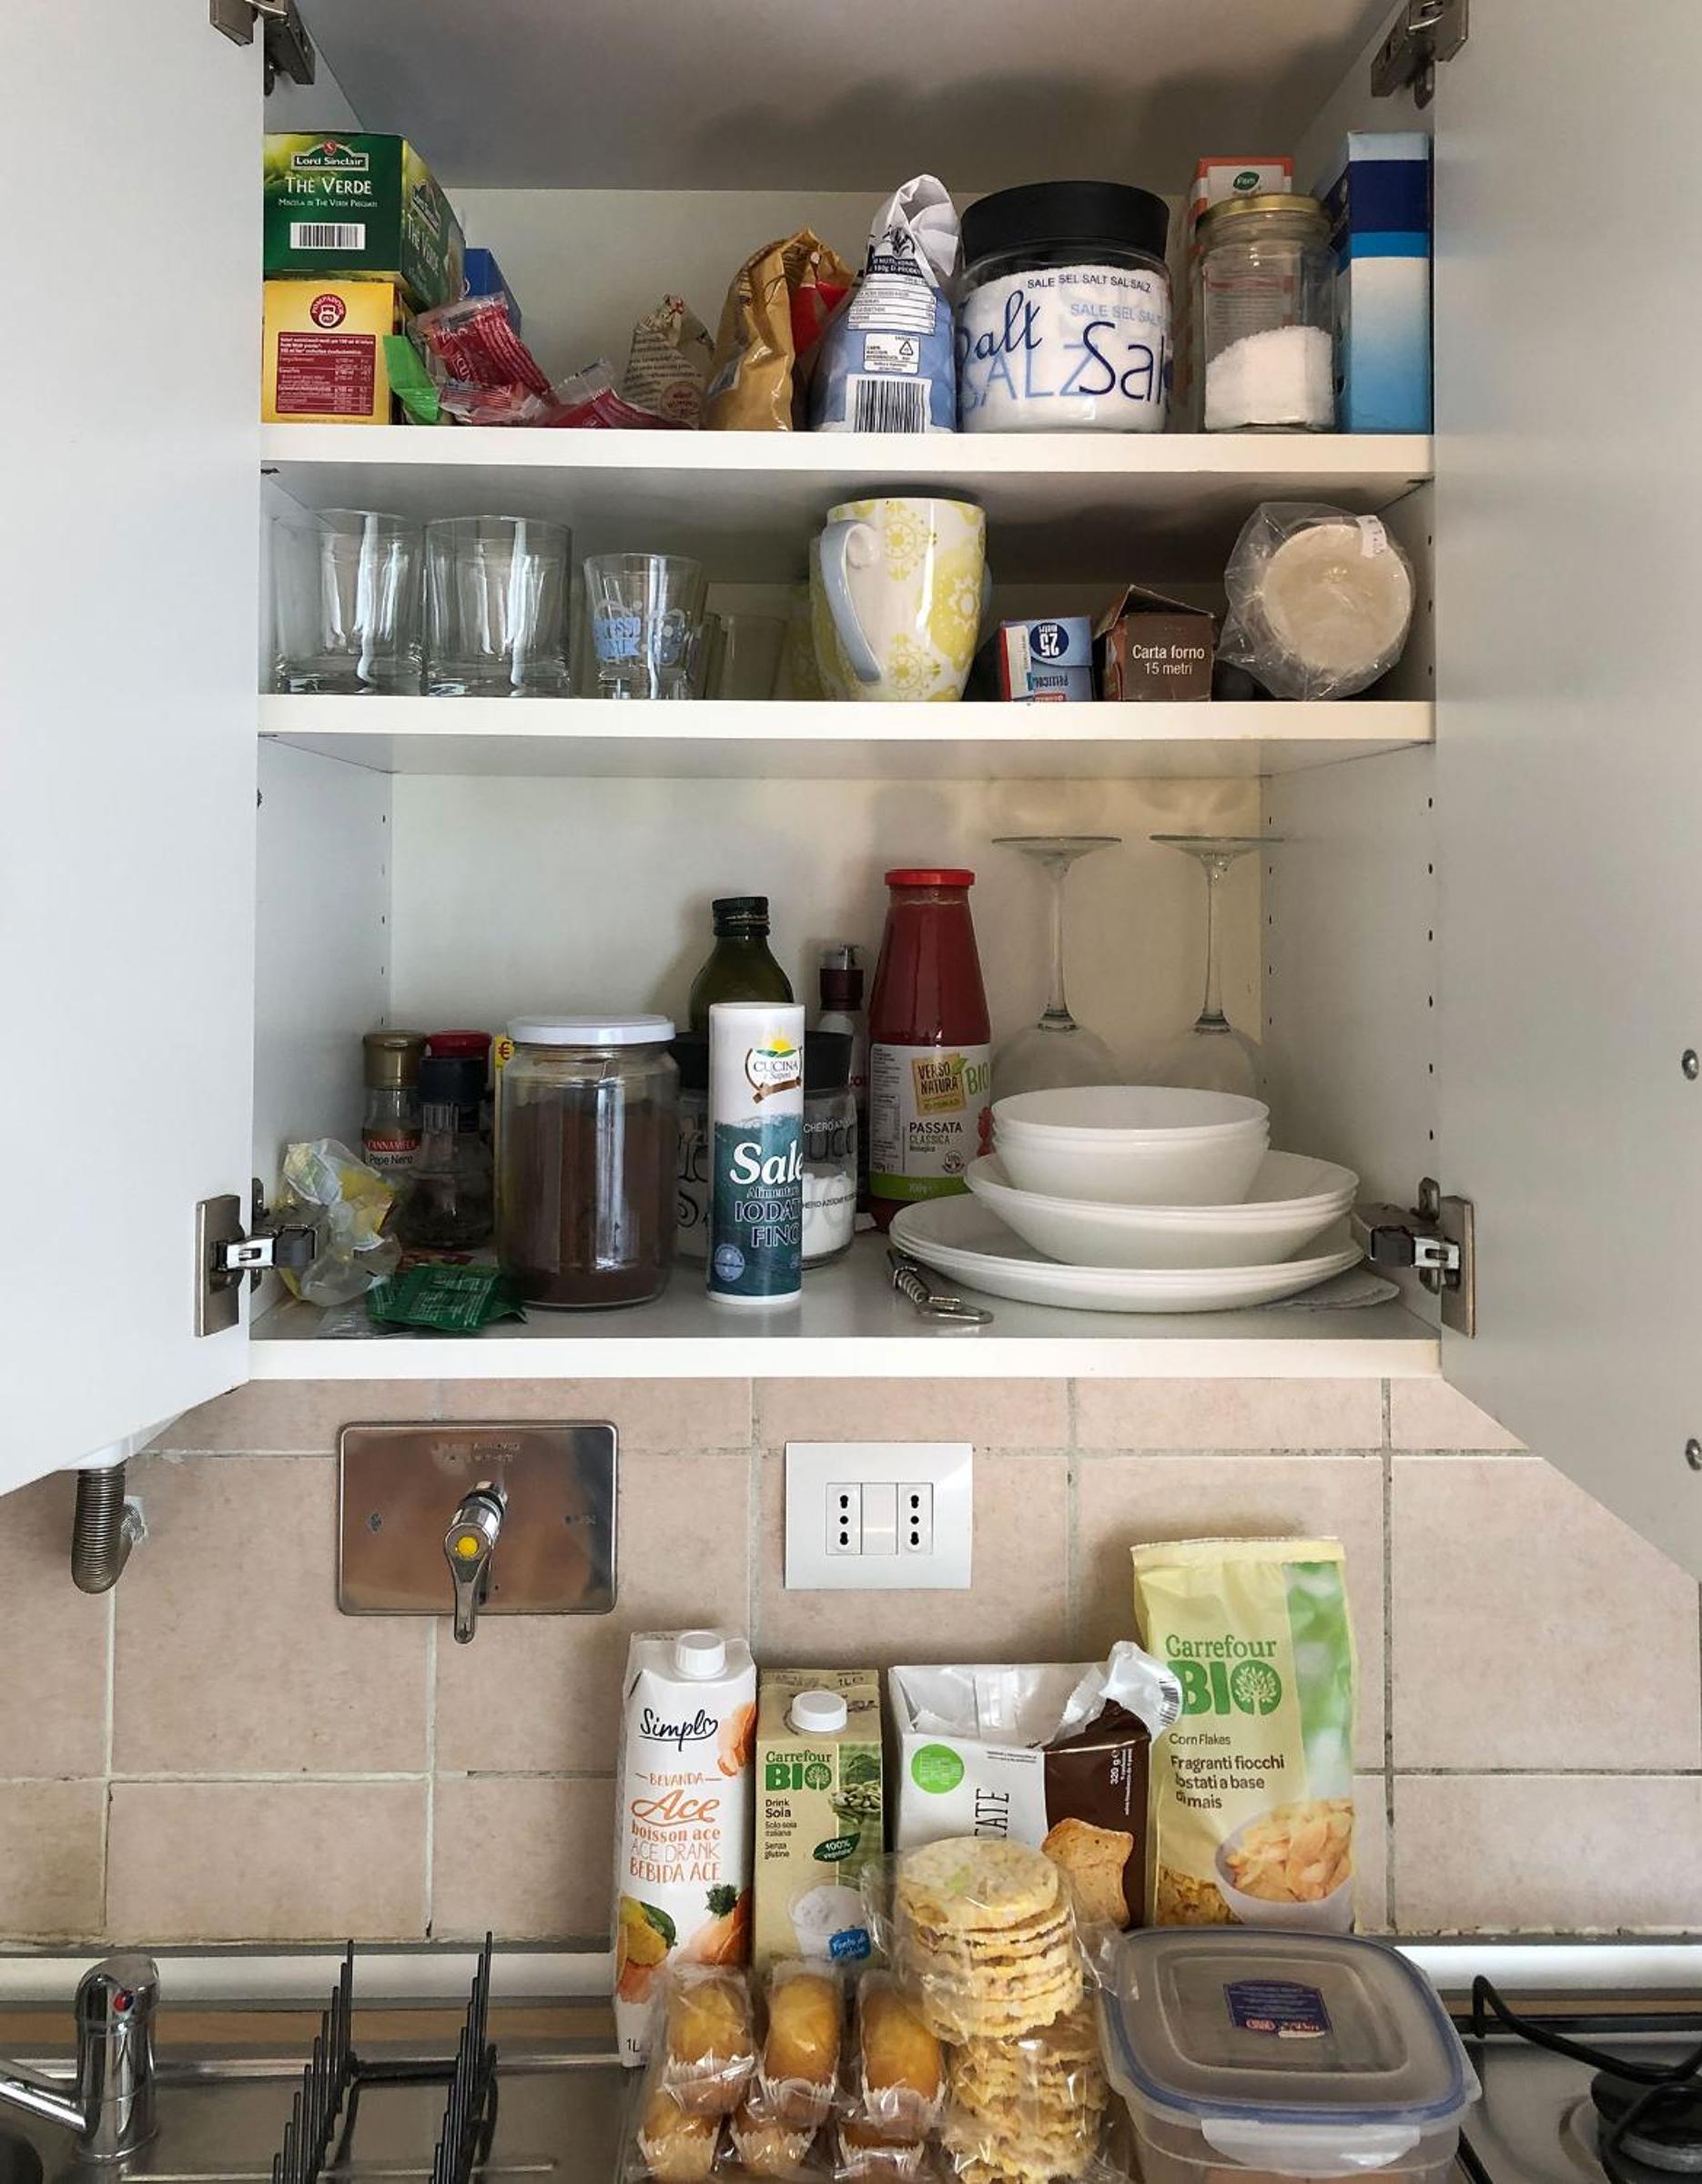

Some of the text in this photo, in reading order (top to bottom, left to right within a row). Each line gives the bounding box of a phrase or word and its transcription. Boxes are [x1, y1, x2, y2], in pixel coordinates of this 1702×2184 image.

[296, 156, 363, 166] Lord Sinclair
[321, 177, 372, 195] VERDE
[1028, 274, 1151, 292] SALE SEL SALT SAL SALZ
[1070, 302, 1108, 317] SALE
[1112, 305, 1136, 320] SEL
[1039, 633, 1060, 657] 25
[1132, 645, 1205, 659] Carta forno
[1145, 662, 1193, 676] 15 metri
[754, 1060, 799, 1072] CUCINA
[917, 1062, 950, 1080] VERSO
[920, 1077, 959, 1095] NATURA
[966, 1062, 990, 1095] BIO
[910, 1122, 963, 1134] PASSATA
[910, 1135, 950, 1146] CLASSICA
[1166, 1634, 1277, 1659] Carrefour
[1170, 1659, 1282, 1715] BIO
[1169, 1732, 1231, 1745] Corn Flakes
[765, 1749, 832, 1763] Carrefour
[1170, 1753, 1284, 1774] Fragranti fiocchi
[650, 1773, 704, 1786] BEVANDA
[765, 1763, 832, 1792] BIO
[1220, 1778, 1228, 1790] a
[1231, 1774, 1265, 1789] base
[632, 1790, 720, 1826] Ace
[765, 1798, 790, 1807] Drink
[1187, 1793, 1222, 1809] mais
[765, 1807, 791, 1818] Soia
[632, 1821, 721, 1843] boisson ace
[631, 1838, 721, 1864] ACE DRANK
[765, 1842, 786, 1850] Senza
[826, 1840, 851, 1851] 100%
[630, 1857, 721, 1884] BEBIDA ACE
